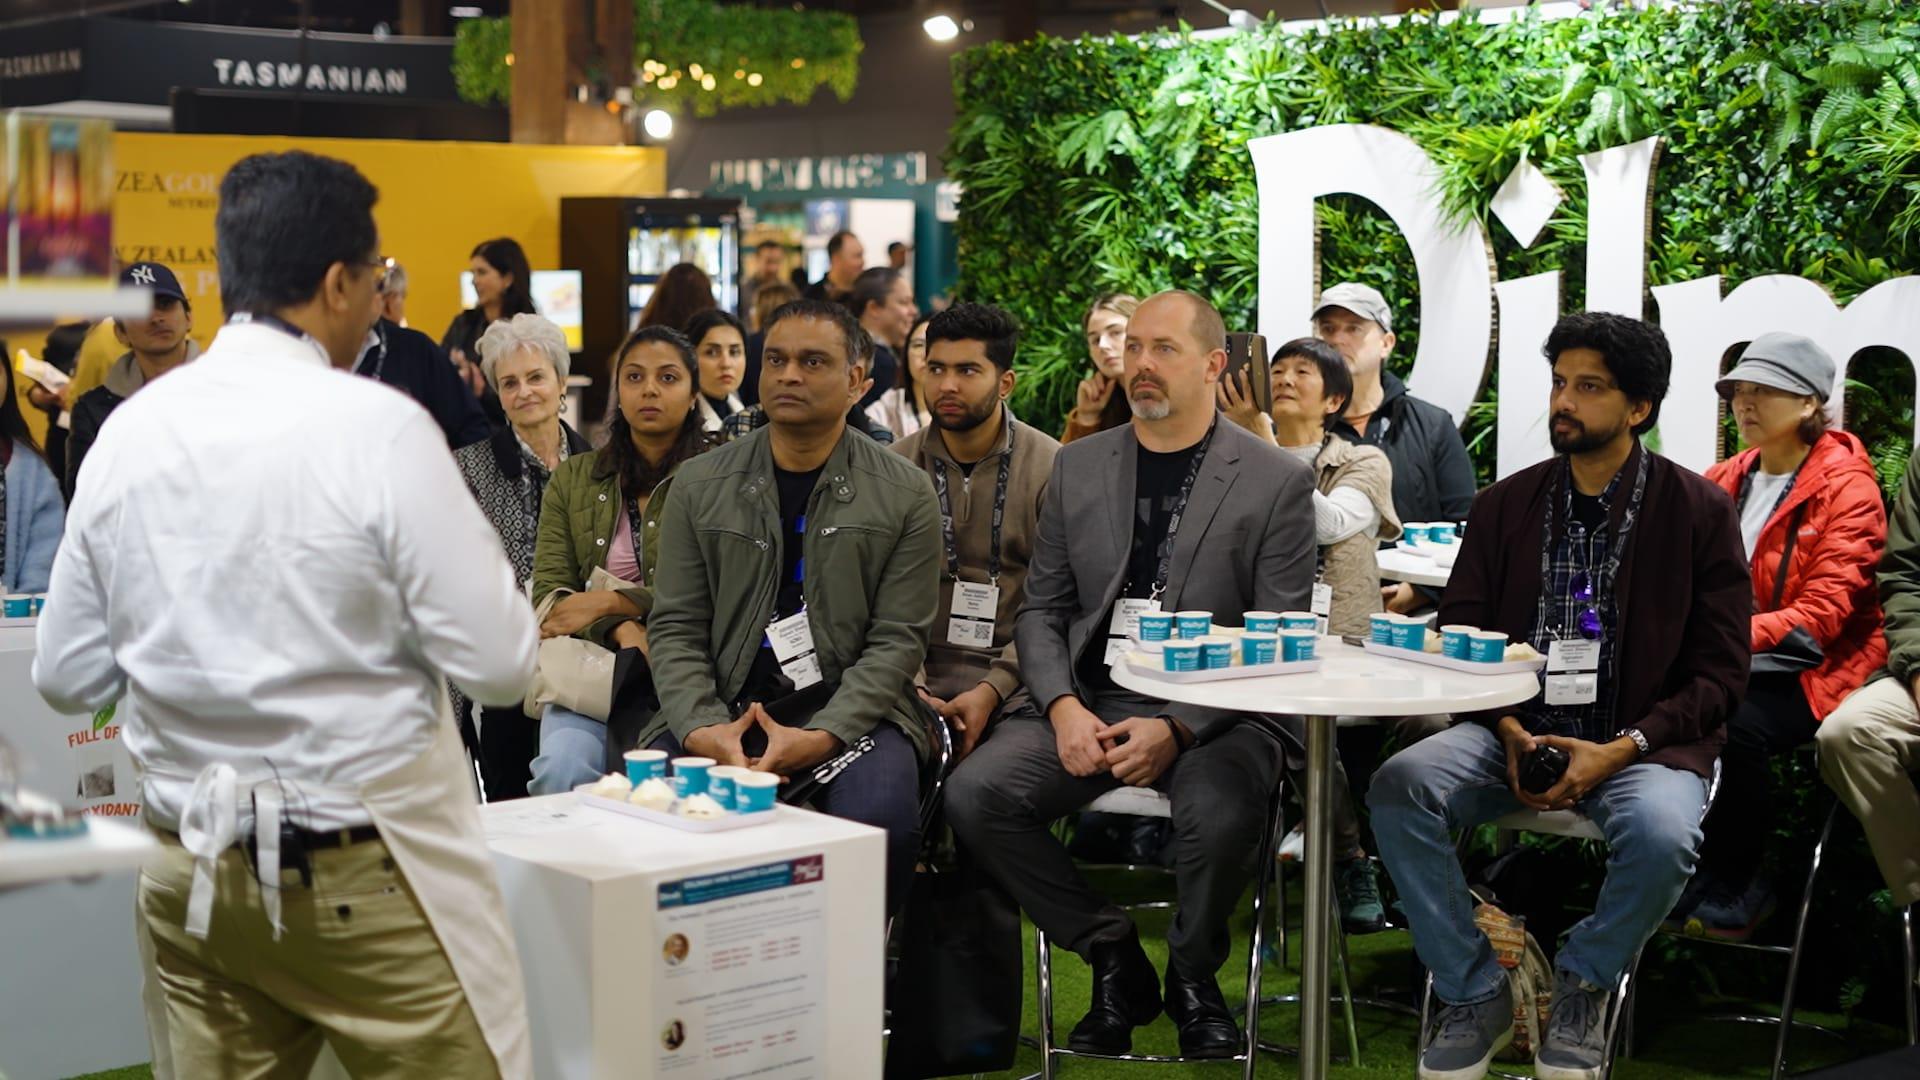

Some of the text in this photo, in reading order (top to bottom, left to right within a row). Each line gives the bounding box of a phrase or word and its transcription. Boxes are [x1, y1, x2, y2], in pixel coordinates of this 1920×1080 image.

[213, 58, 407, 93] TASMANIAN
[68, 726, 120, 748] FULL OF
